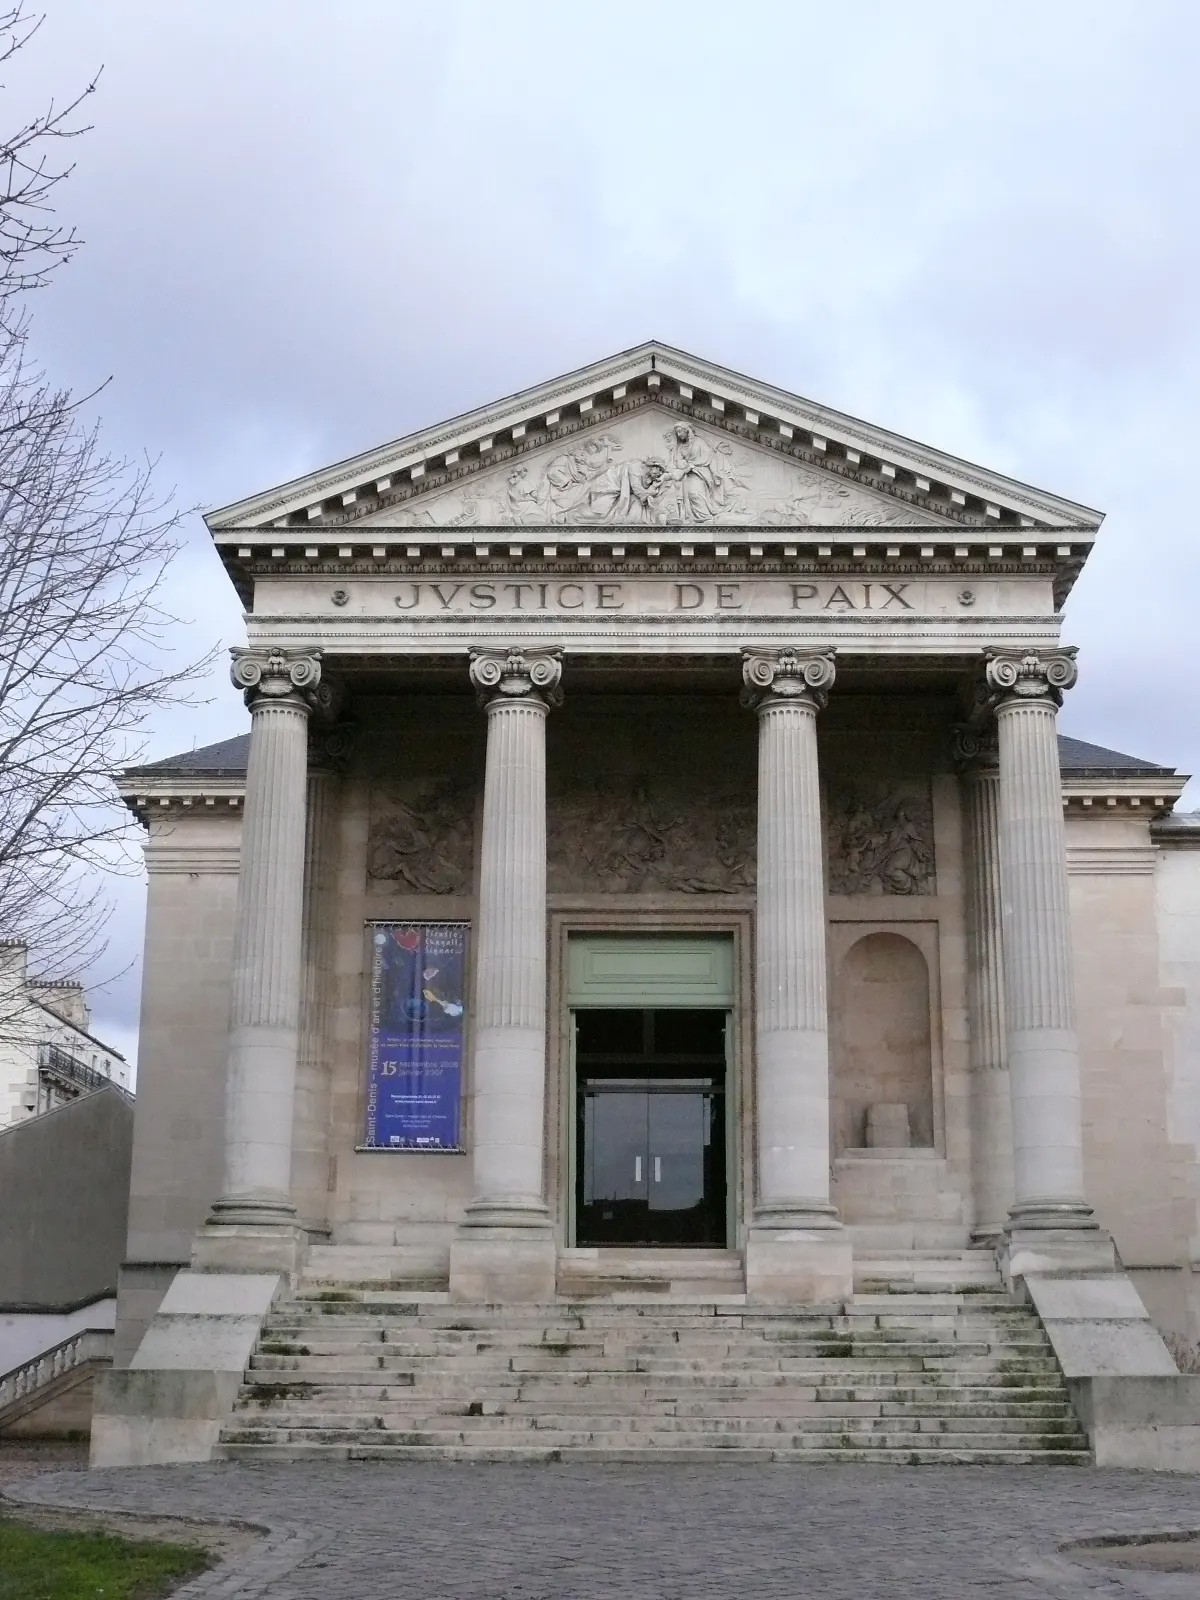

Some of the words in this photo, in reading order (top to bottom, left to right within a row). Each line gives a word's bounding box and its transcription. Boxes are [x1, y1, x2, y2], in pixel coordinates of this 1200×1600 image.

[393, 583, 625, 610] JVSTICE
[674, 583, 743, 610] DE
[789, 583, 915, 610] PAIX
[372, 946, 383, 994] d'histoire
[372, 997, 381, 1007] et
[370, 1010, 381, 1034] d'art
[369, 1037, 380, 1071] musée
[381, 1060, 397, 1076] 15
[366, 1083, 378, 1144] Saint-Denis
